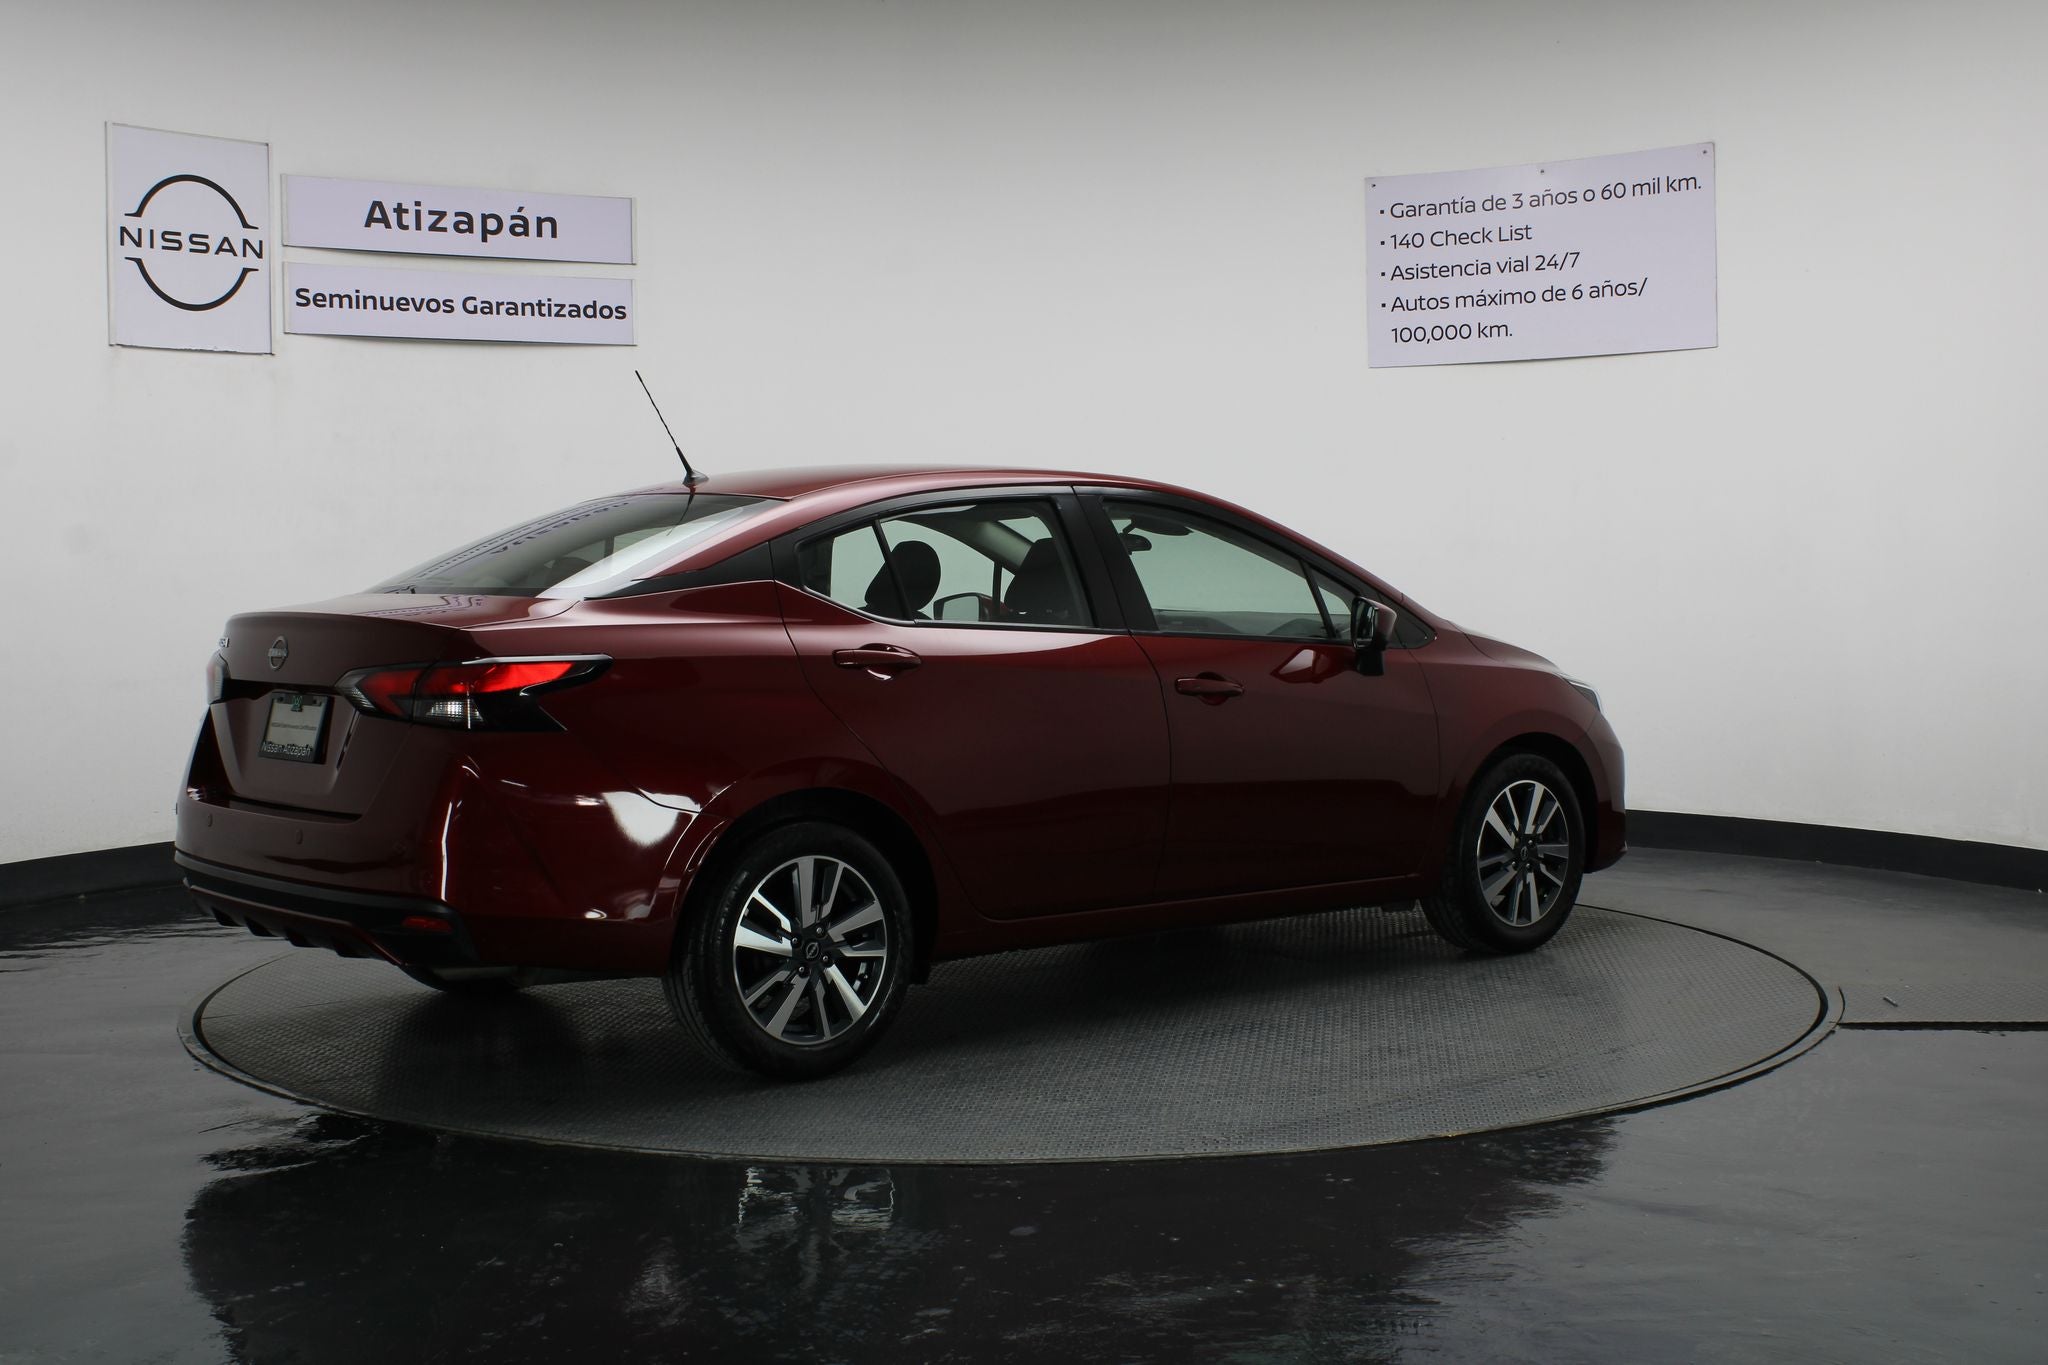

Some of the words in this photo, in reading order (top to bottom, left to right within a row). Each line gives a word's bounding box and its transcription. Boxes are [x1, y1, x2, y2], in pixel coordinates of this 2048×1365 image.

[1390, 196, 1476, 218] Garantía
[1482, 195, 1507, 211] de
[1513, 193, 1524, 209] 3
[1529, 189, 1578, 208] años
[1583, 189, 1596, 203] o
[1601, 183, 1627, 200] 60
[1633, 177, 1661, 197] mil
[1666, 175, 1702, 193] km.
[364, 201, 558, 243] Atizapán
[1390, 233, 1425, 249] 140
[1431, 227, 1494, 247] Check
[1499, 225, 1533, 242] List
[120, 226, 263, 259] NISSAN
[1390, 262, 1492, 281] Asistencia
[1496, 256, 1529, 274] vial
[1535, 252, 1581, 271] 24/7
[296, 288, 455, 313] Seminuevos
[462, 296, 627, 320] Garantizados
[1391, 296, 1450, 312] Autos
[1456, 289, 1537, 309] máximo
[1542, 285, 1567, 302] de
[1572, 284, 1584, 300] 6
[1589, 278, 1648, 299] años/
[1391, 324, 1472, 344] 100,000
[1477, 322, 1513, 339] km.
